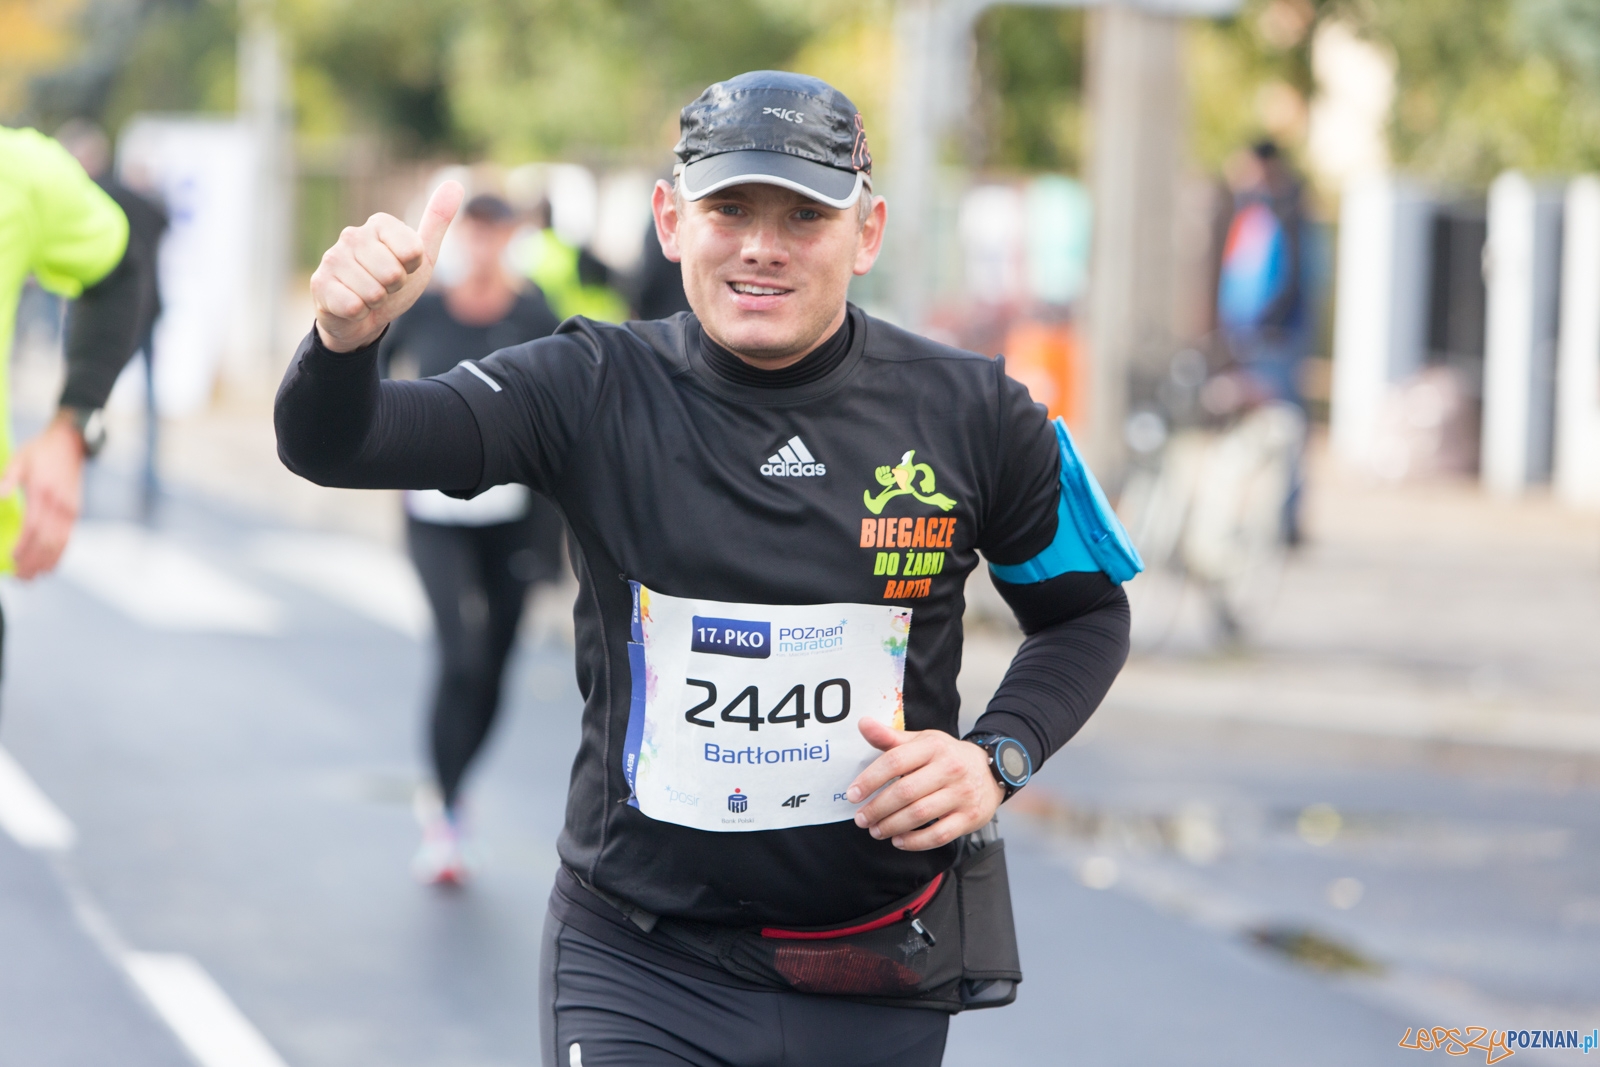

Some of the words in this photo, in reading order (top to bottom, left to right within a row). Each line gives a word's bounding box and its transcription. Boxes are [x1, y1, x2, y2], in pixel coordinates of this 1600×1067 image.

[759, 461, 827, 477] adidas
[860, 517, 957, 548] BIEGACZE
[873, 552, 900, 576] DO
[902, 549, 945, 576] ŻABKI
[697, 627, 722, 644] 17.
[724, 629, 764, 648] PKO
[779, 636, 843, 652] maraton
[685, 677, 851, 731] 2440
[704, 739, 830, 764] Bartłomiej
[781, 793, 810, 809] 4F
